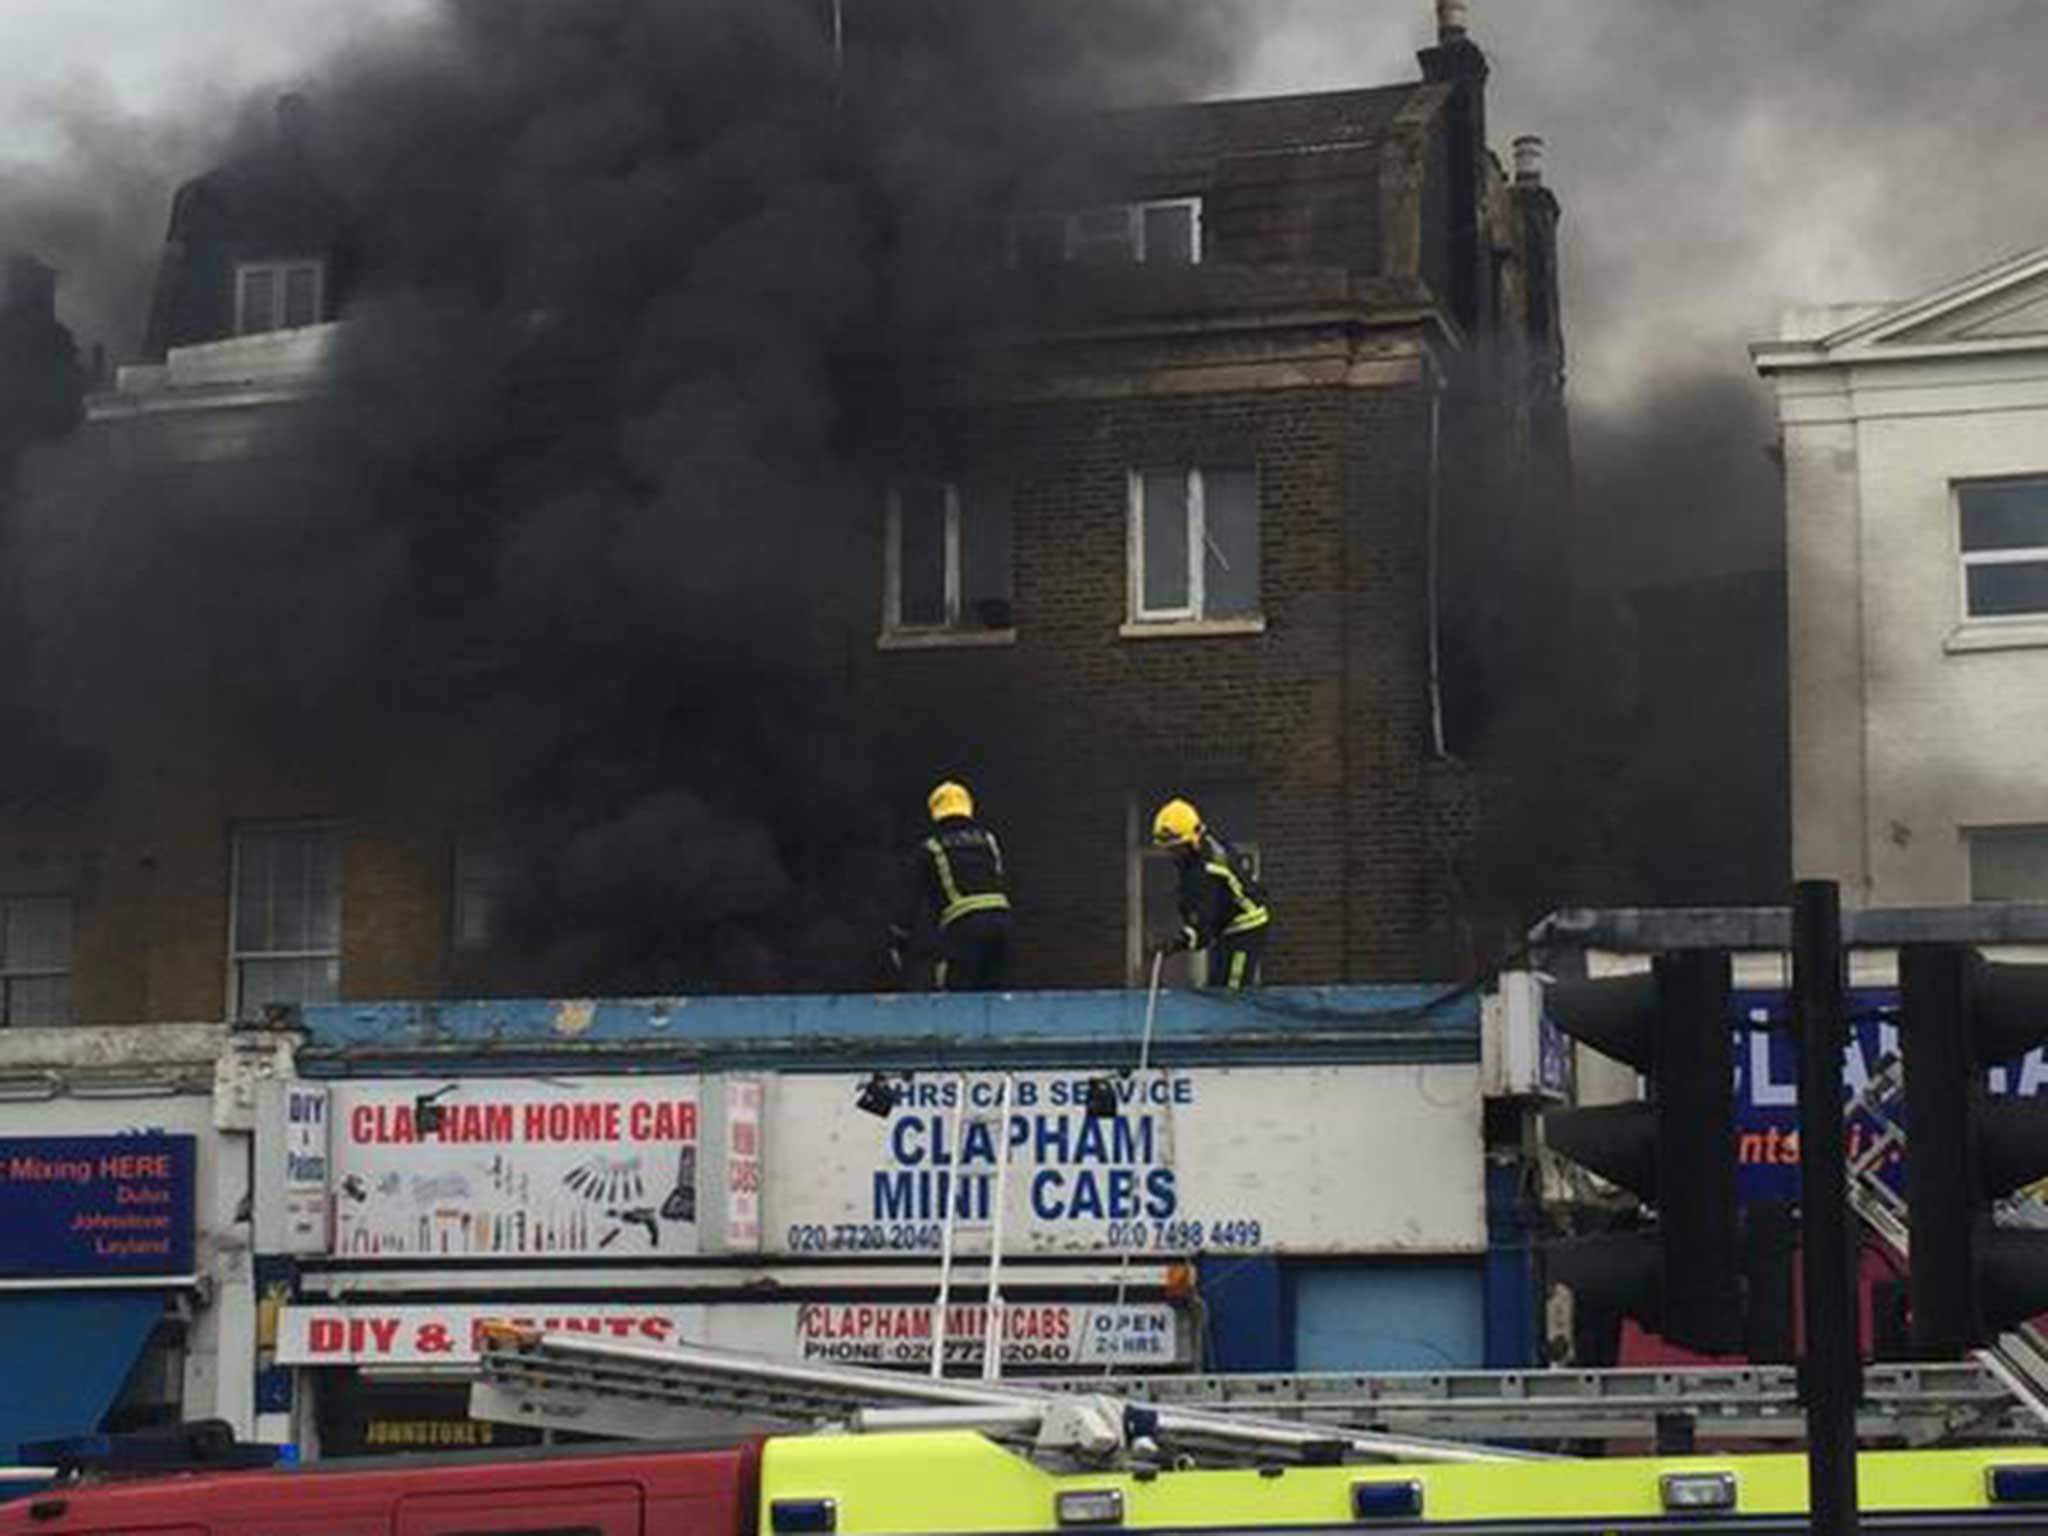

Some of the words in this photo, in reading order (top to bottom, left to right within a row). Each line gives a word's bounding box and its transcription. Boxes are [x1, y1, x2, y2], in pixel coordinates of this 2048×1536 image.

[1050, 1078, 1193, 1107] SEVICE
[351, 1105, 513, 1144] CLAHAM
[525, 1103, 621, 1142] HOME
[629, 1102, 697, 1141] CAR
[891, 1115, 1153, 1166] CLAPHAM
[10, 1156, 91, 1185] Mixing
[100, 1154, 169, 1179] HERE
[873, 1170, 990, 1221] MINI
[1031, 1168, 1178, 1221] CABS
[308, 1318, 400, 1354] DIY
[415, 1318, 453, 1354] &
[806, 1307, 931, 1338] CLAPHAM
[1095, 1313, 1166, 1333] OPEN
